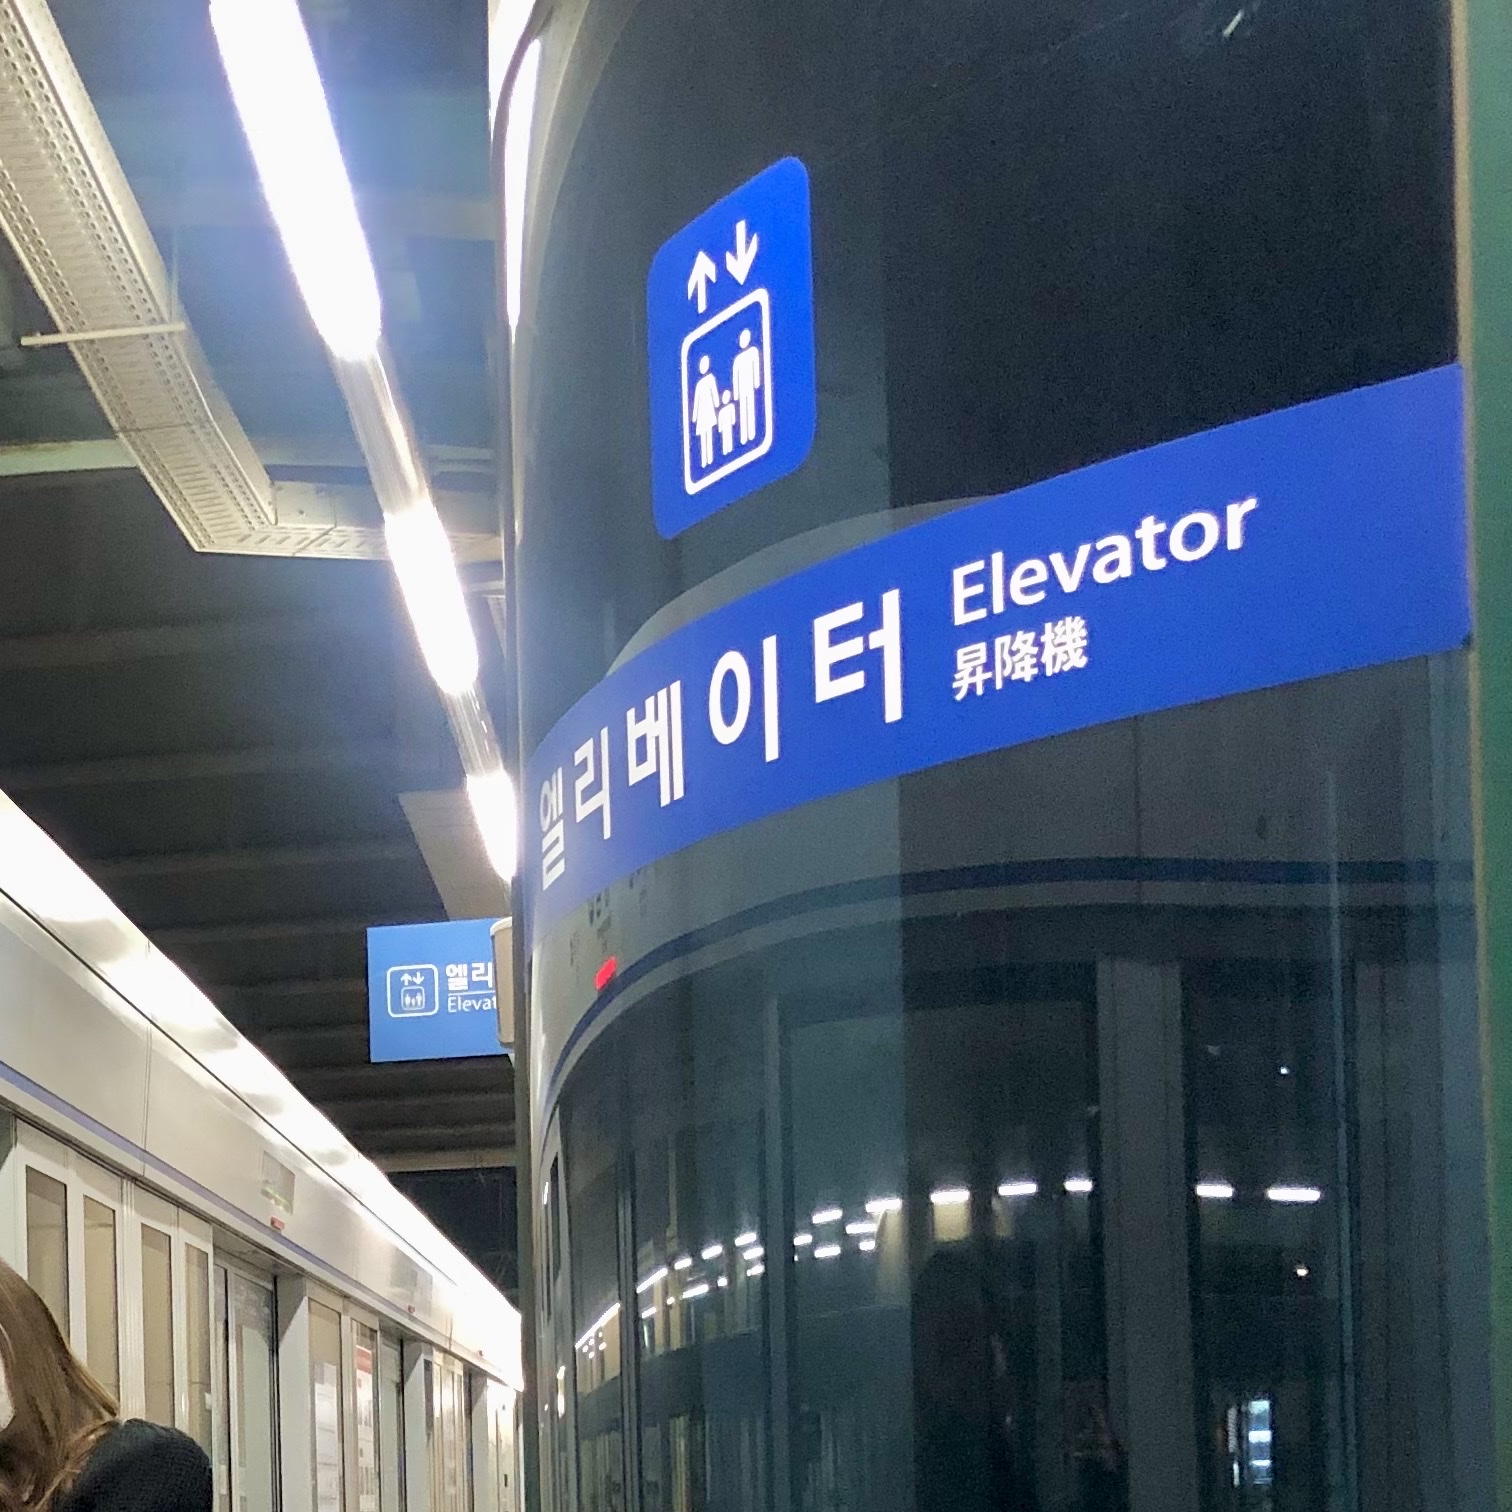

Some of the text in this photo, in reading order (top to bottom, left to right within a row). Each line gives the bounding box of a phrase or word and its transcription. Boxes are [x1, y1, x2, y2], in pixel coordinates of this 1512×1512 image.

[951, 497, 1258, 626] Elevator
[952, 616, 1088, 701] 昇降機
[539, 587, 903, 892] 엘리베이터
